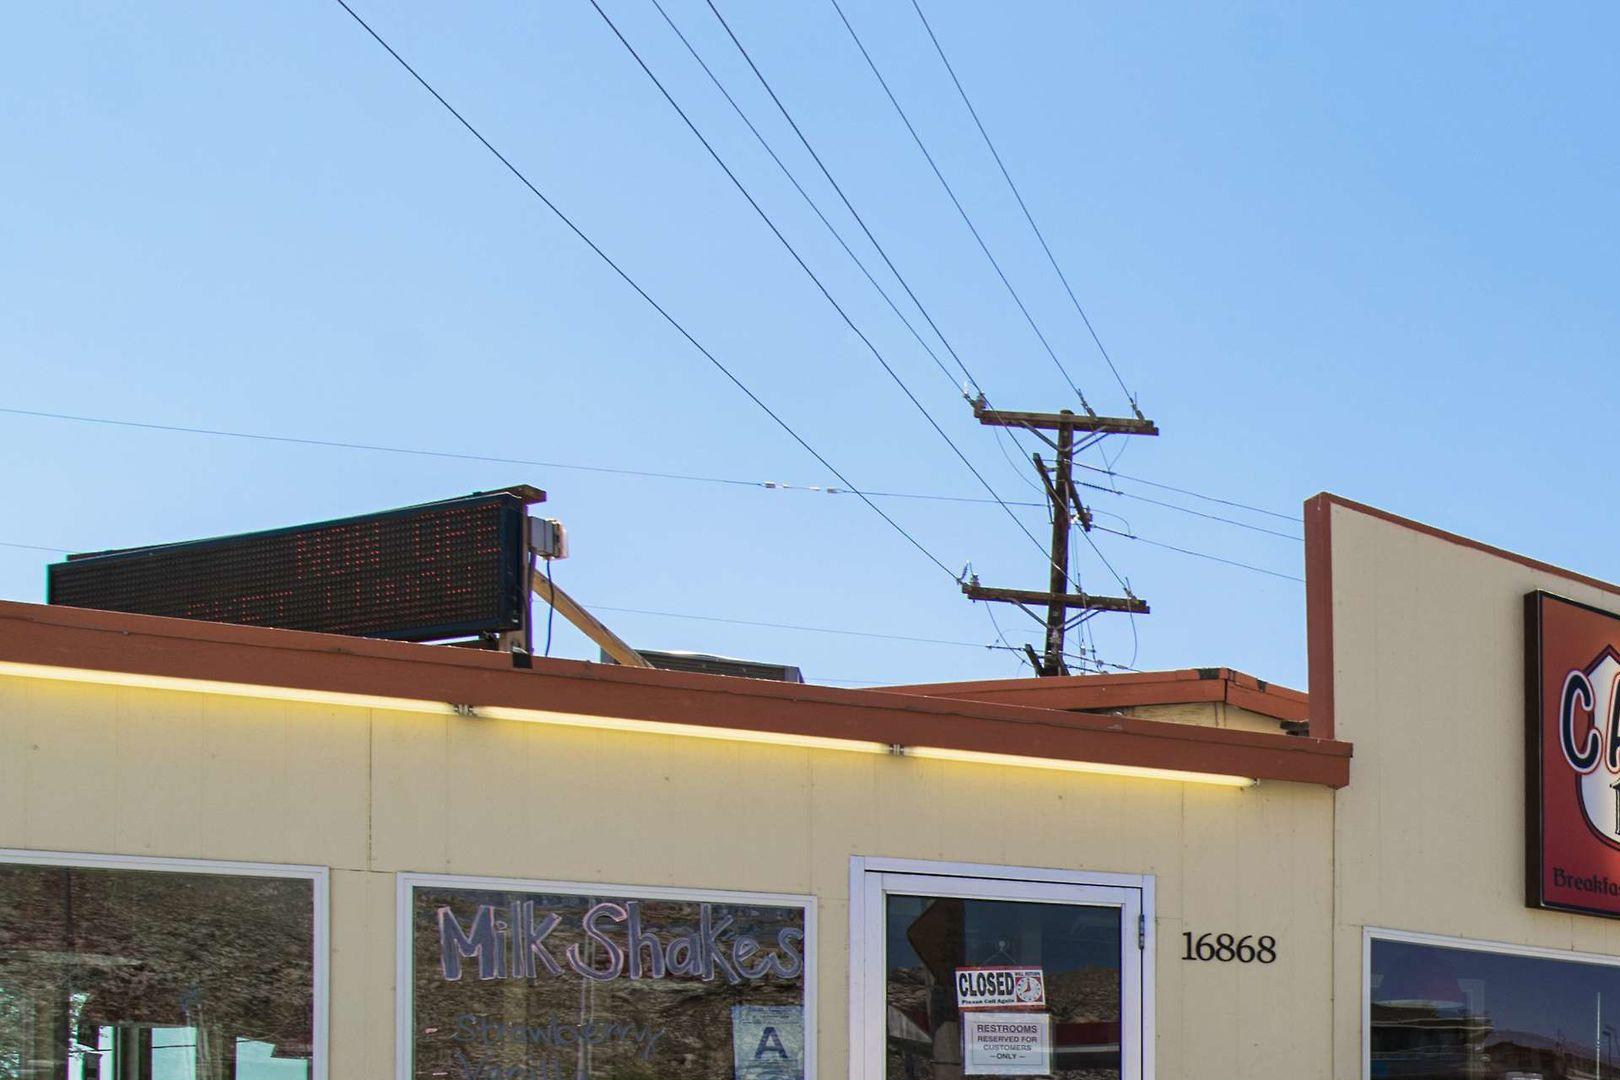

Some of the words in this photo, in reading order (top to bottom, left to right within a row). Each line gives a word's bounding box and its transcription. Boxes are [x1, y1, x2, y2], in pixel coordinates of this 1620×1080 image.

[1181, 931, 1277, 964] 16868
[959, 971, 1015, 997] CLOSED
[977, 1024, 1037, 1034] RESTROOMS
[754, 1026, 789, 1060] A
[977, 1035, 1019, 1043] RESERVED
[1021, 1035, 1038, 1043] FOR
[996, 1052, 1017, 1060] ONLY
